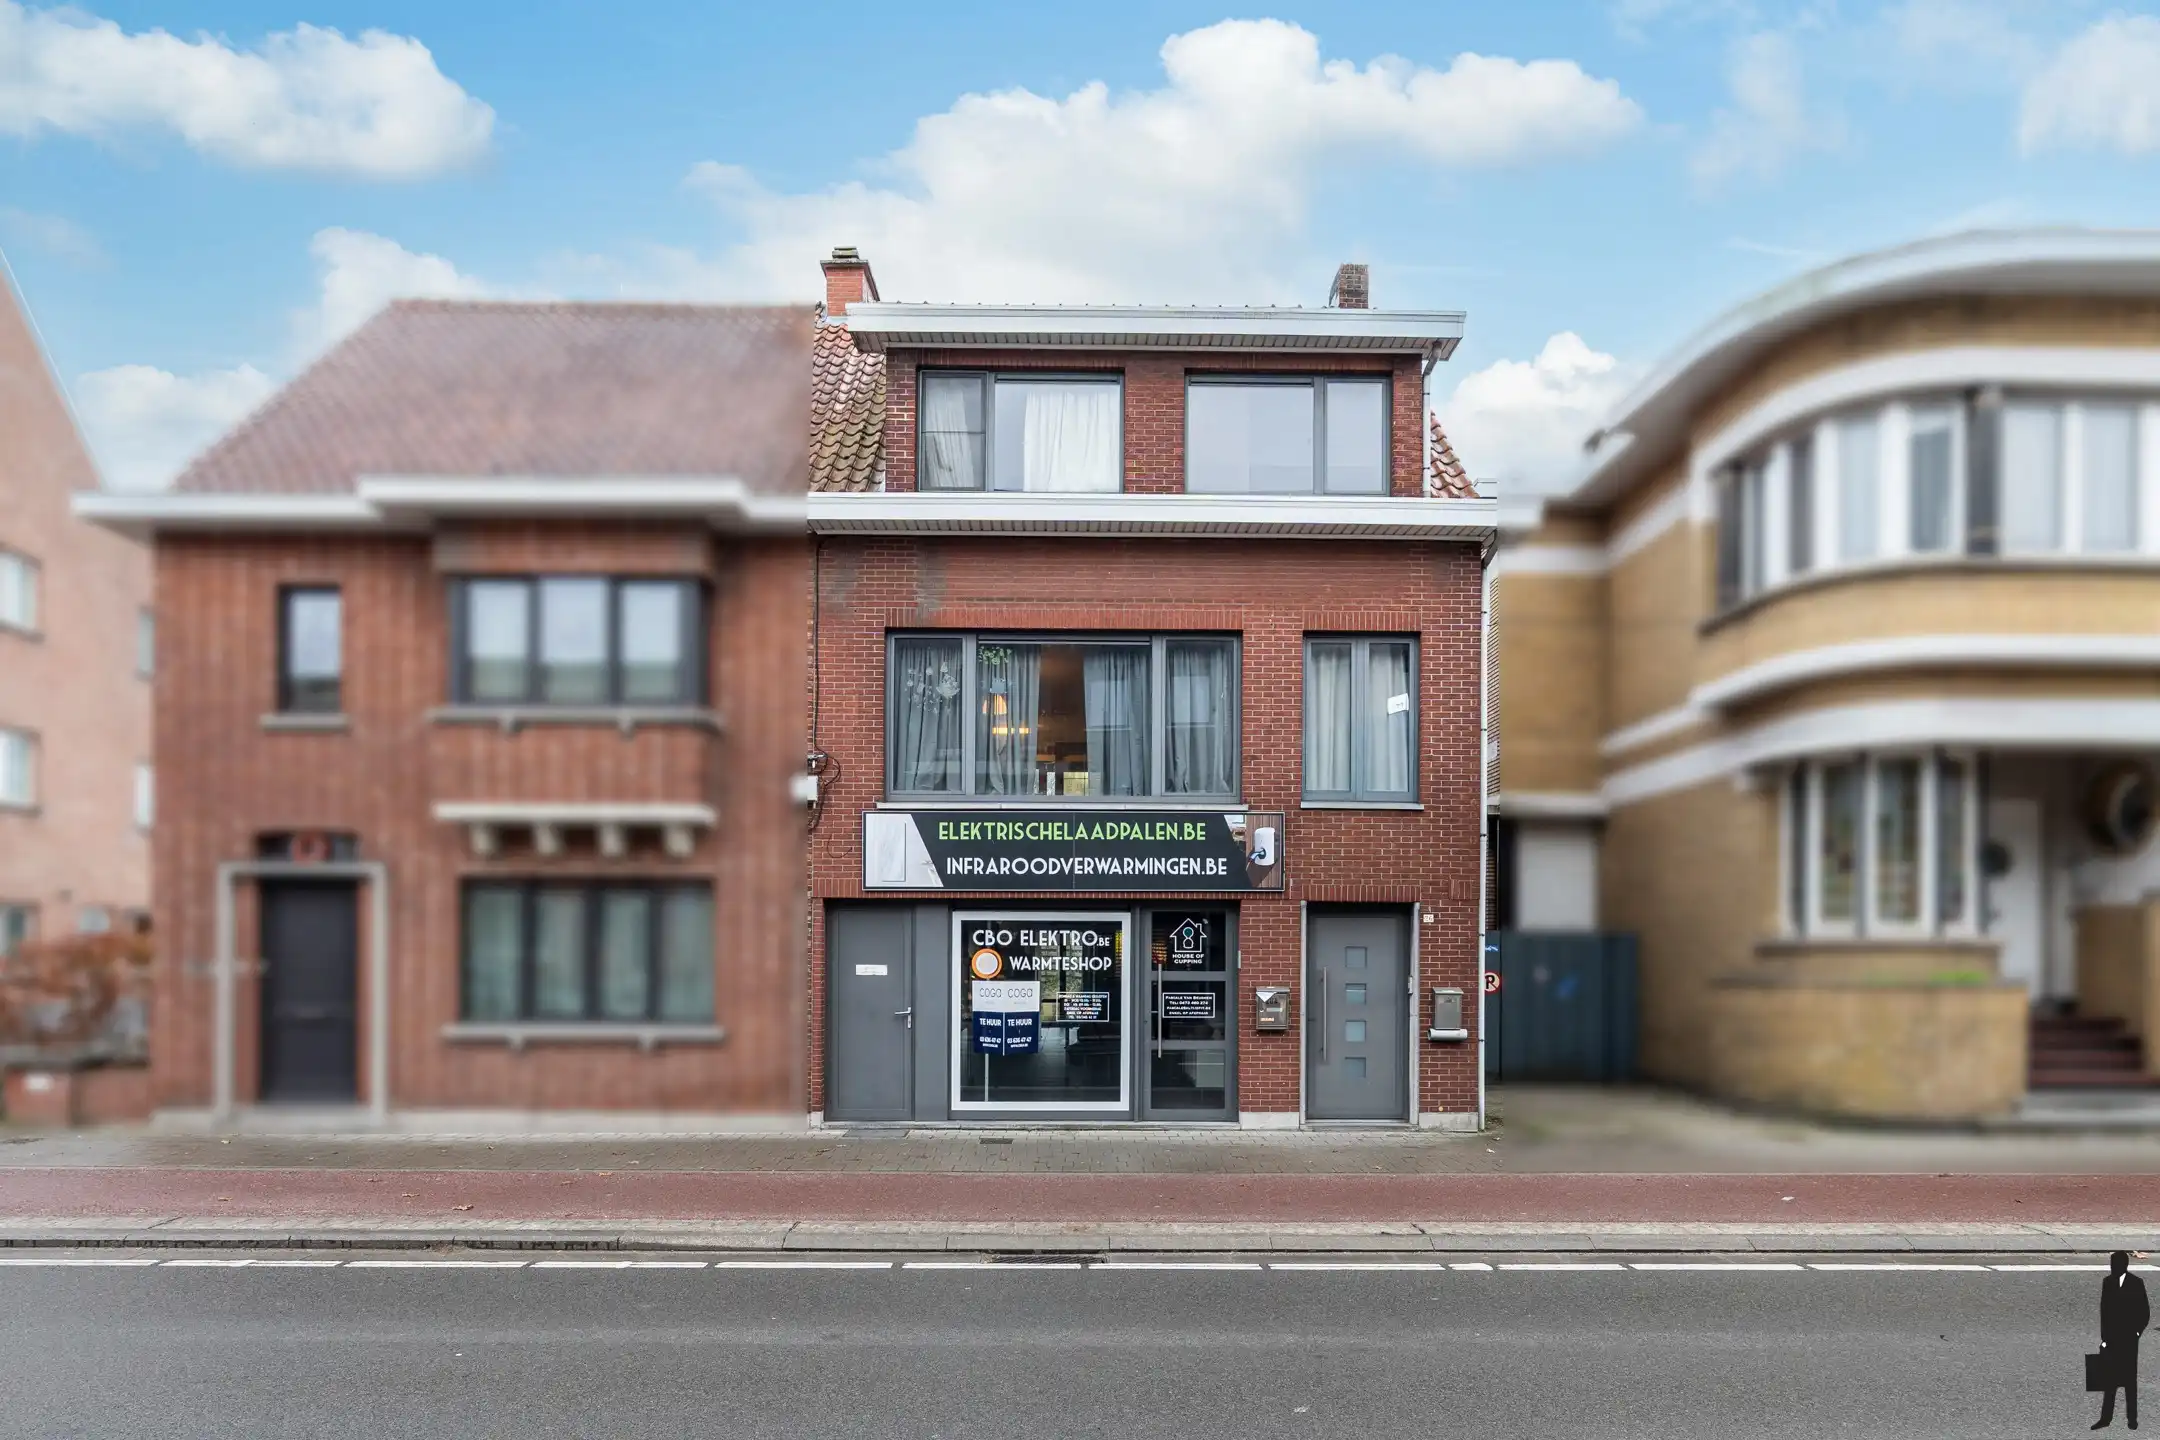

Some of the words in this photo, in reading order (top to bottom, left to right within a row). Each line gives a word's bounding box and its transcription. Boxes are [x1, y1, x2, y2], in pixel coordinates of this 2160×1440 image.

[938, 821, 1206, 841] ELEKTRISCHELAADPALEN.BE
[946, 857, 1228, 876] INFRAROODVERWARMINGEN.BE
[972, 929, 1013, 946] CBO
[1009, 956, 1112, 971] WARMTESHOP
[986, 1018, 1002, 1026] HUUR
[1015, 1018, 1033, 1026] HUUR
